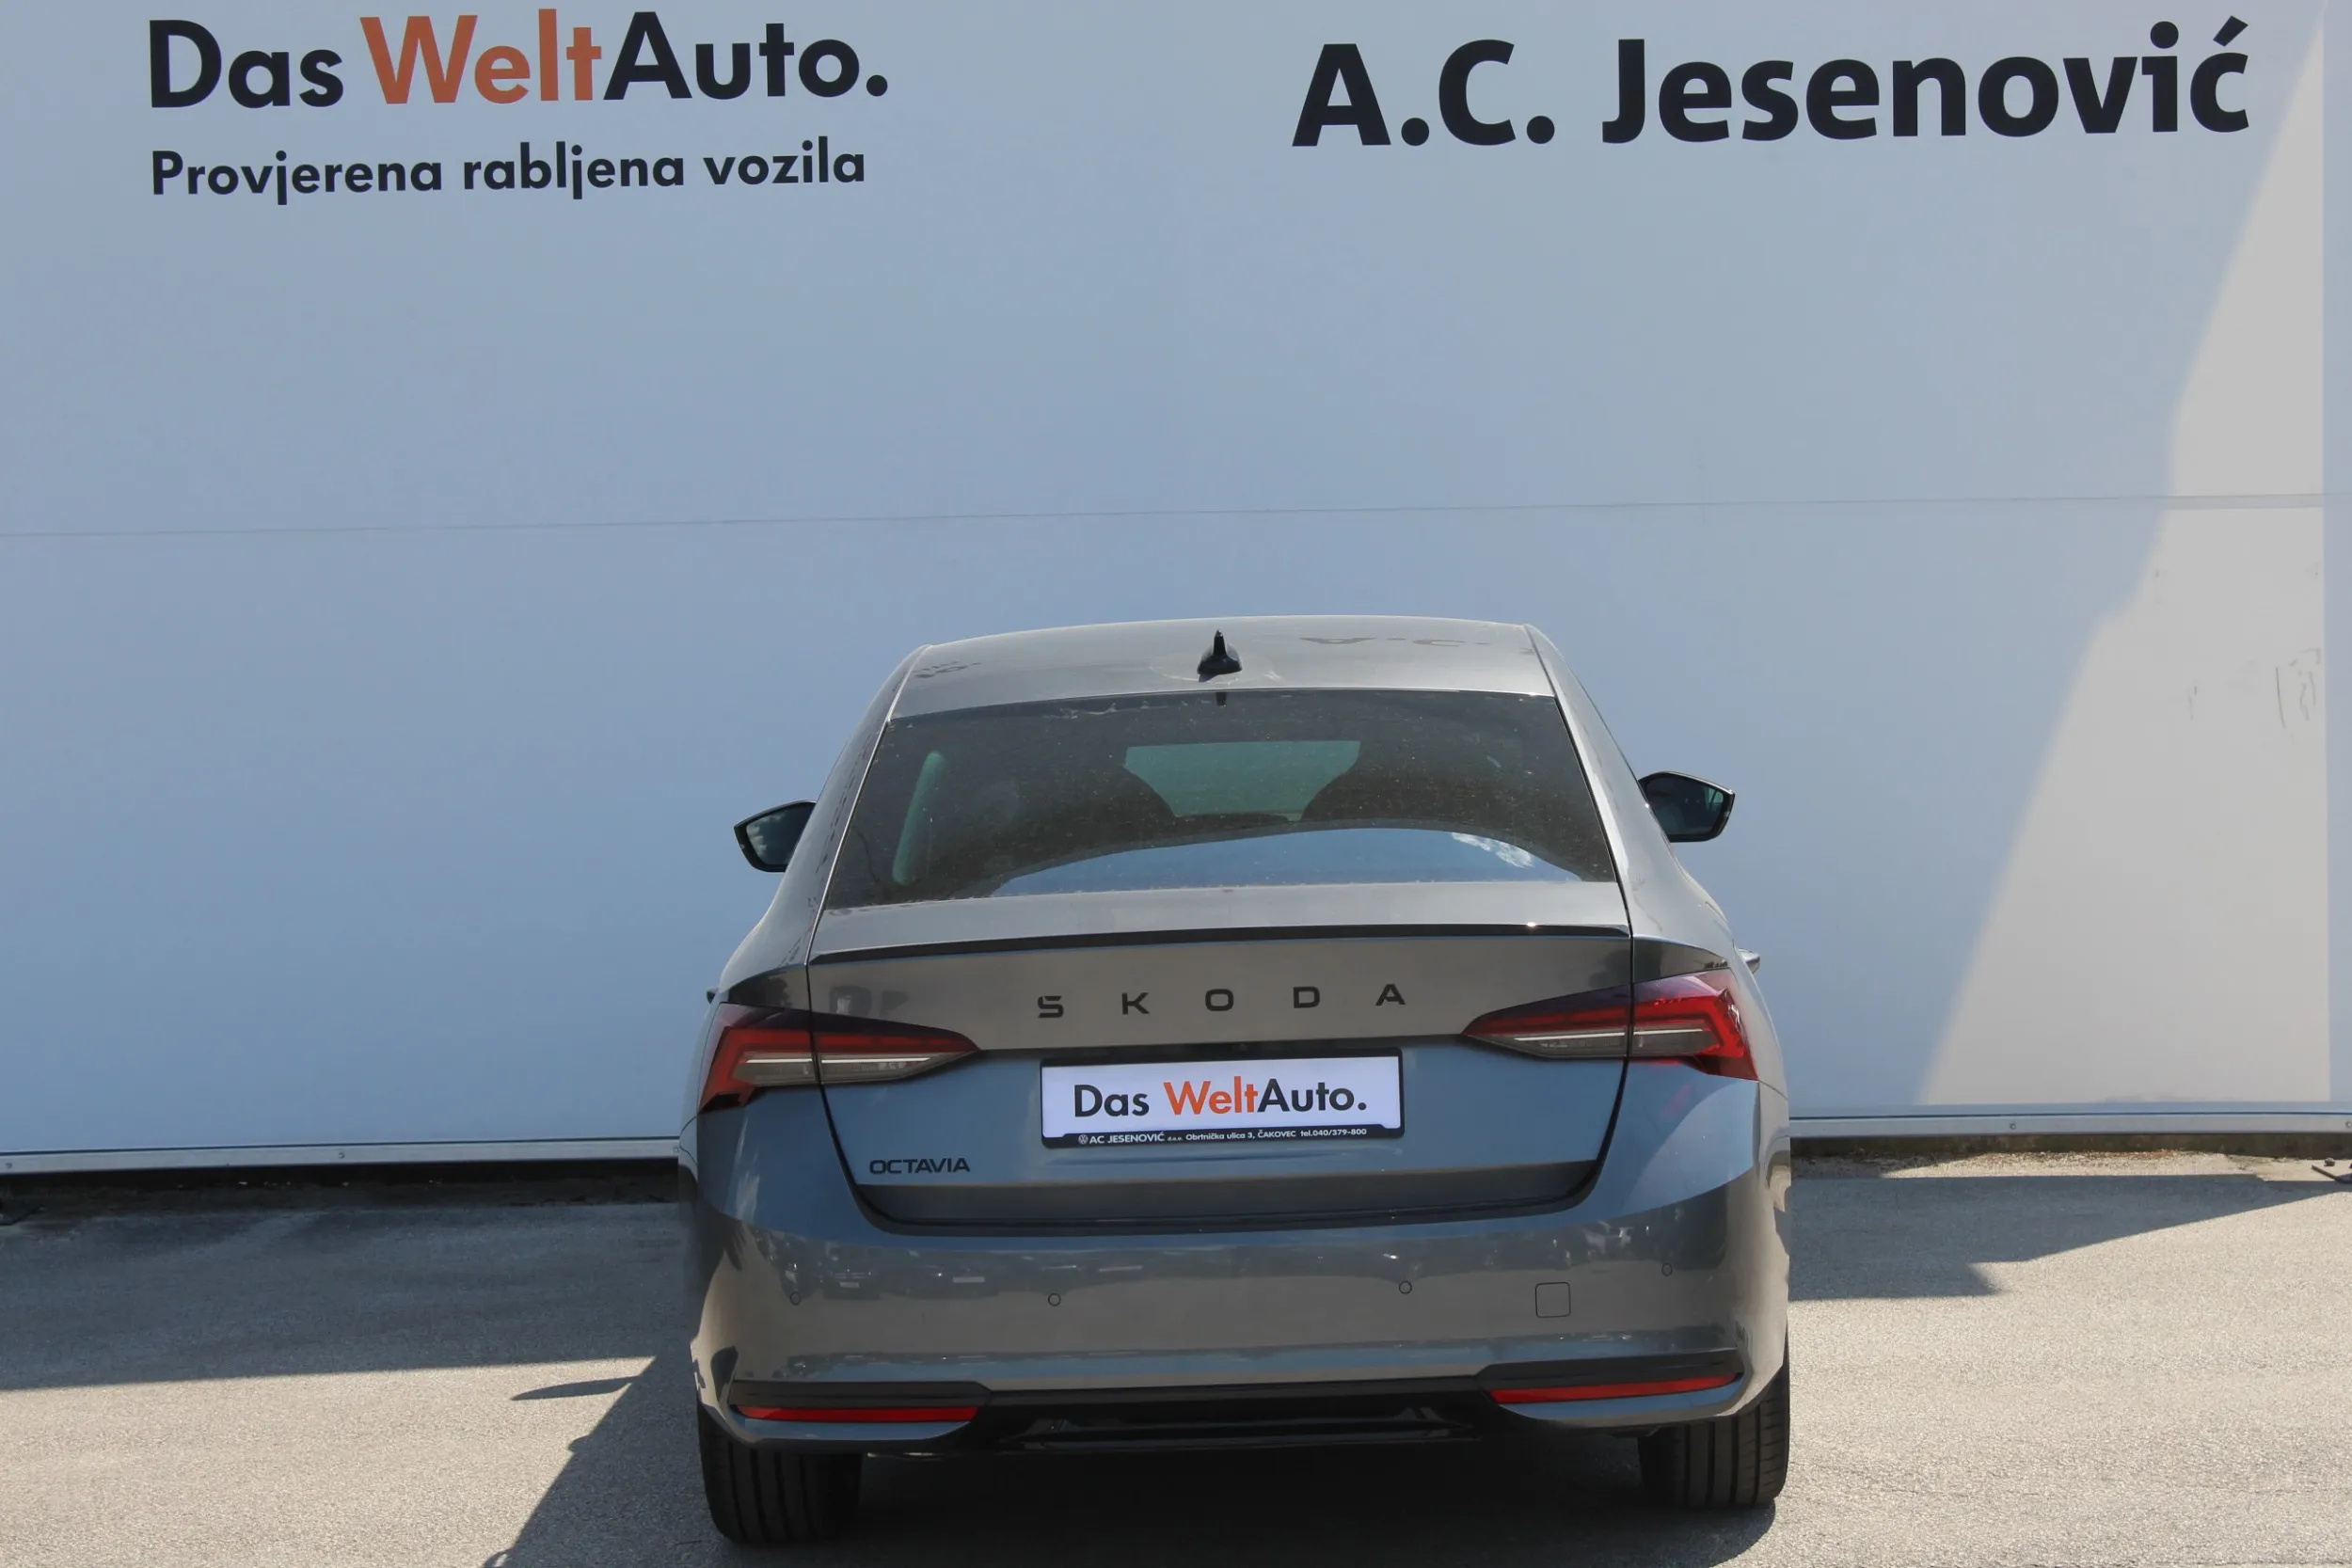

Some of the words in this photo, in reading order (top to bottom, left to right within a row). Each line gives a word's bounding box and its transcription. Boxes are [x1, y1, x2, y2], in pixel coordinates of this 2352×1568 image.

[150, 19, 344, 109] Das
[360, 8, 888, 103] WeltAuto.
[1293, 39, 1555, 147] A.C.
[1602, 15, 2249, 144] Jesenović
[151, 150, 442, 205] Provjerena
[463, 141, 684, 200] rabljena
[703, 135, 865, 185] vozila
[1073, 1084, 1150, 1117] Das
[1163, 1075, 1367, 1116] WeltAuto.
[1089, 1135, 1104, 1144] AC
[1107, 1132, 1166, 1144] JESENOVIĆ
[1185, 1132, 1225, 1141] Obrtnička
[1226, 1132, 1246, 1140] ulica
[1258, 1129, 1296, 1138] ČAKOVEC
[869, 1157, 971, 1175] OCTAVIA
